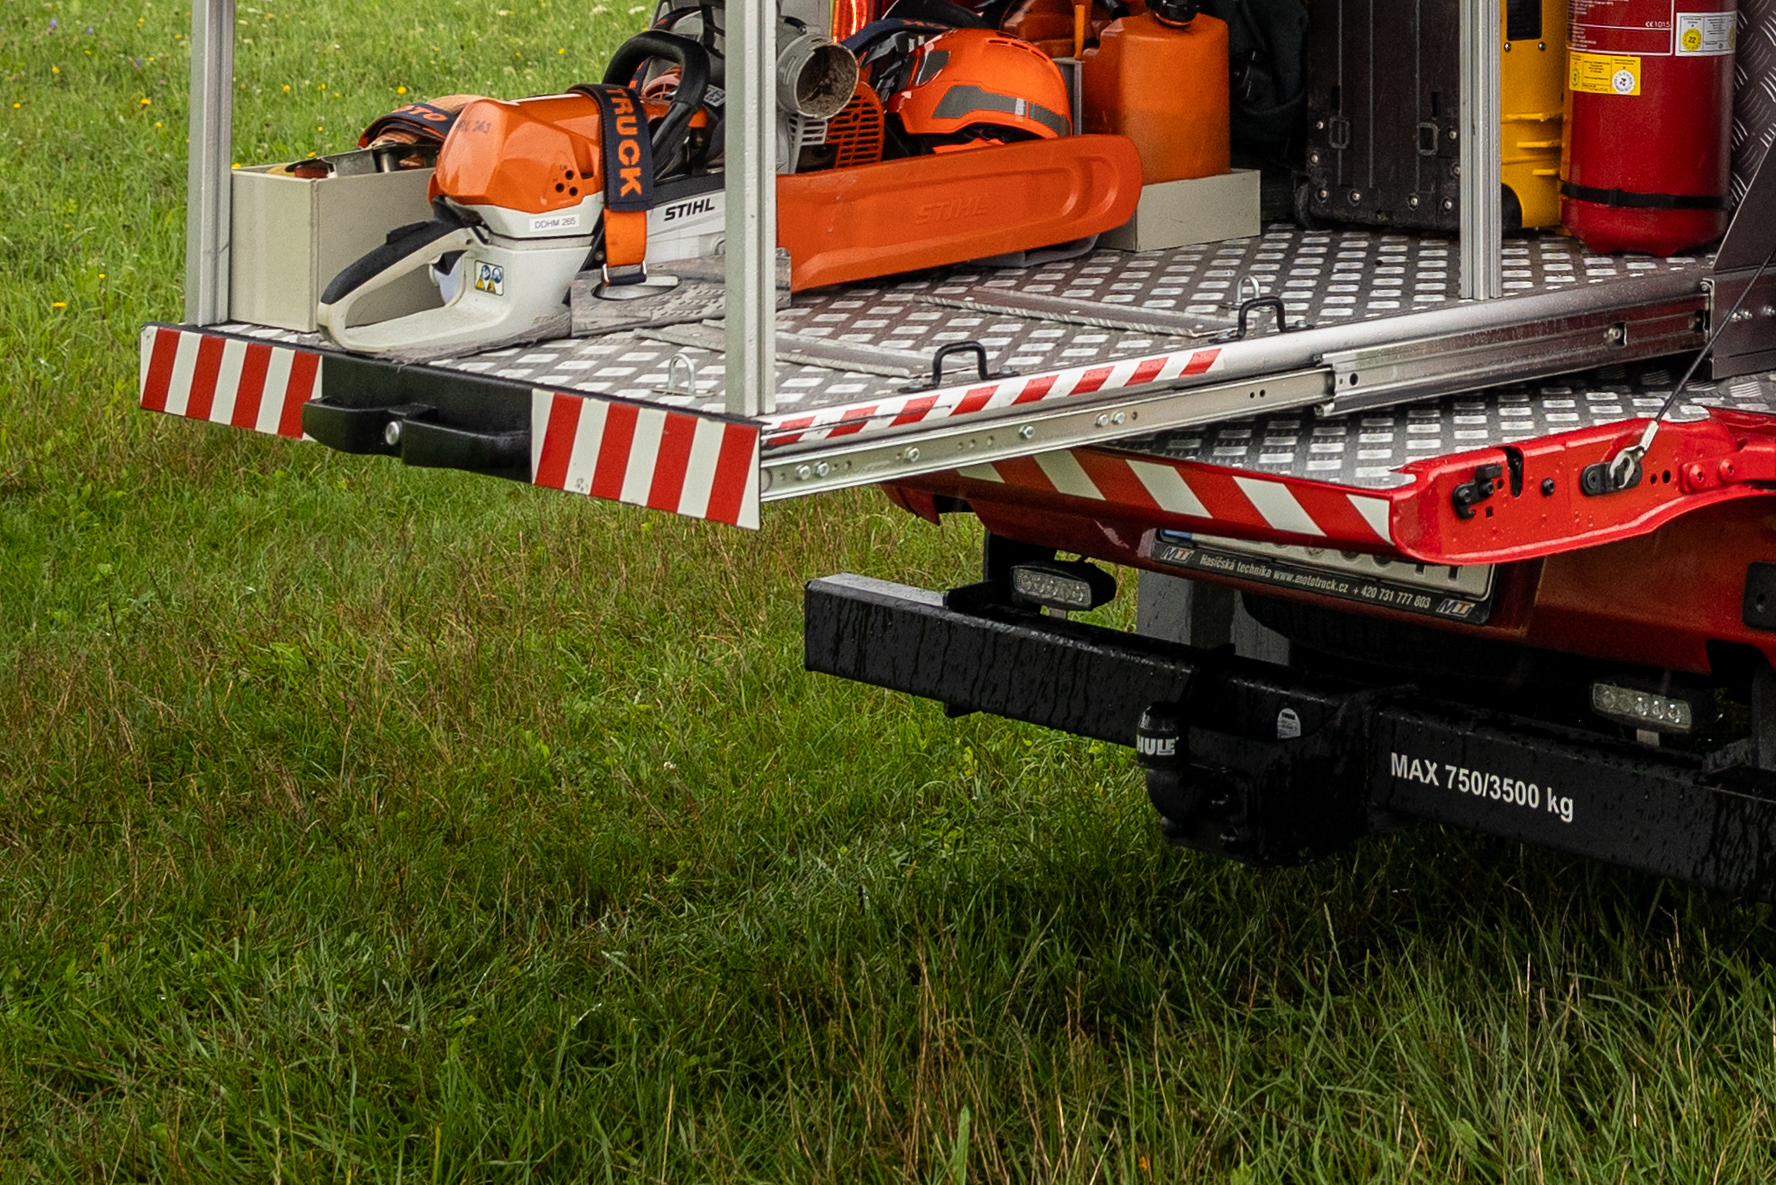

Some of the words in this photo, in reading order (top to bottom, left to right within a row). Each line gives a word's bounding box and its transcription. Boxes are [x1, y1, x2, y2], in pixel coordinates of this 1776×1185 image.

[605, 88, 642, 198] TRUCK
[664, 198, 715, 222] STIHL
[915, 195, 987, 225] STIHL
[1200, 554, 1235, 571] Hasičská
[1236, 561, 1272, 578] technika
[1273, 569, 1349, 593] www.mototruck.cz
[1361, 585, 1377, 599] 420
[1379, 589, 1395, 602] 731
[1395, 593, 1413, 605] 777
[1413, 596, 1431, 609] 803
[1136, 737, 1176, 757] HULE
[1391, 752, 1439, 787] MAX
[1445, 765, 1540, 809] 750/3500
[1547, 787, 1574, 823] kg
